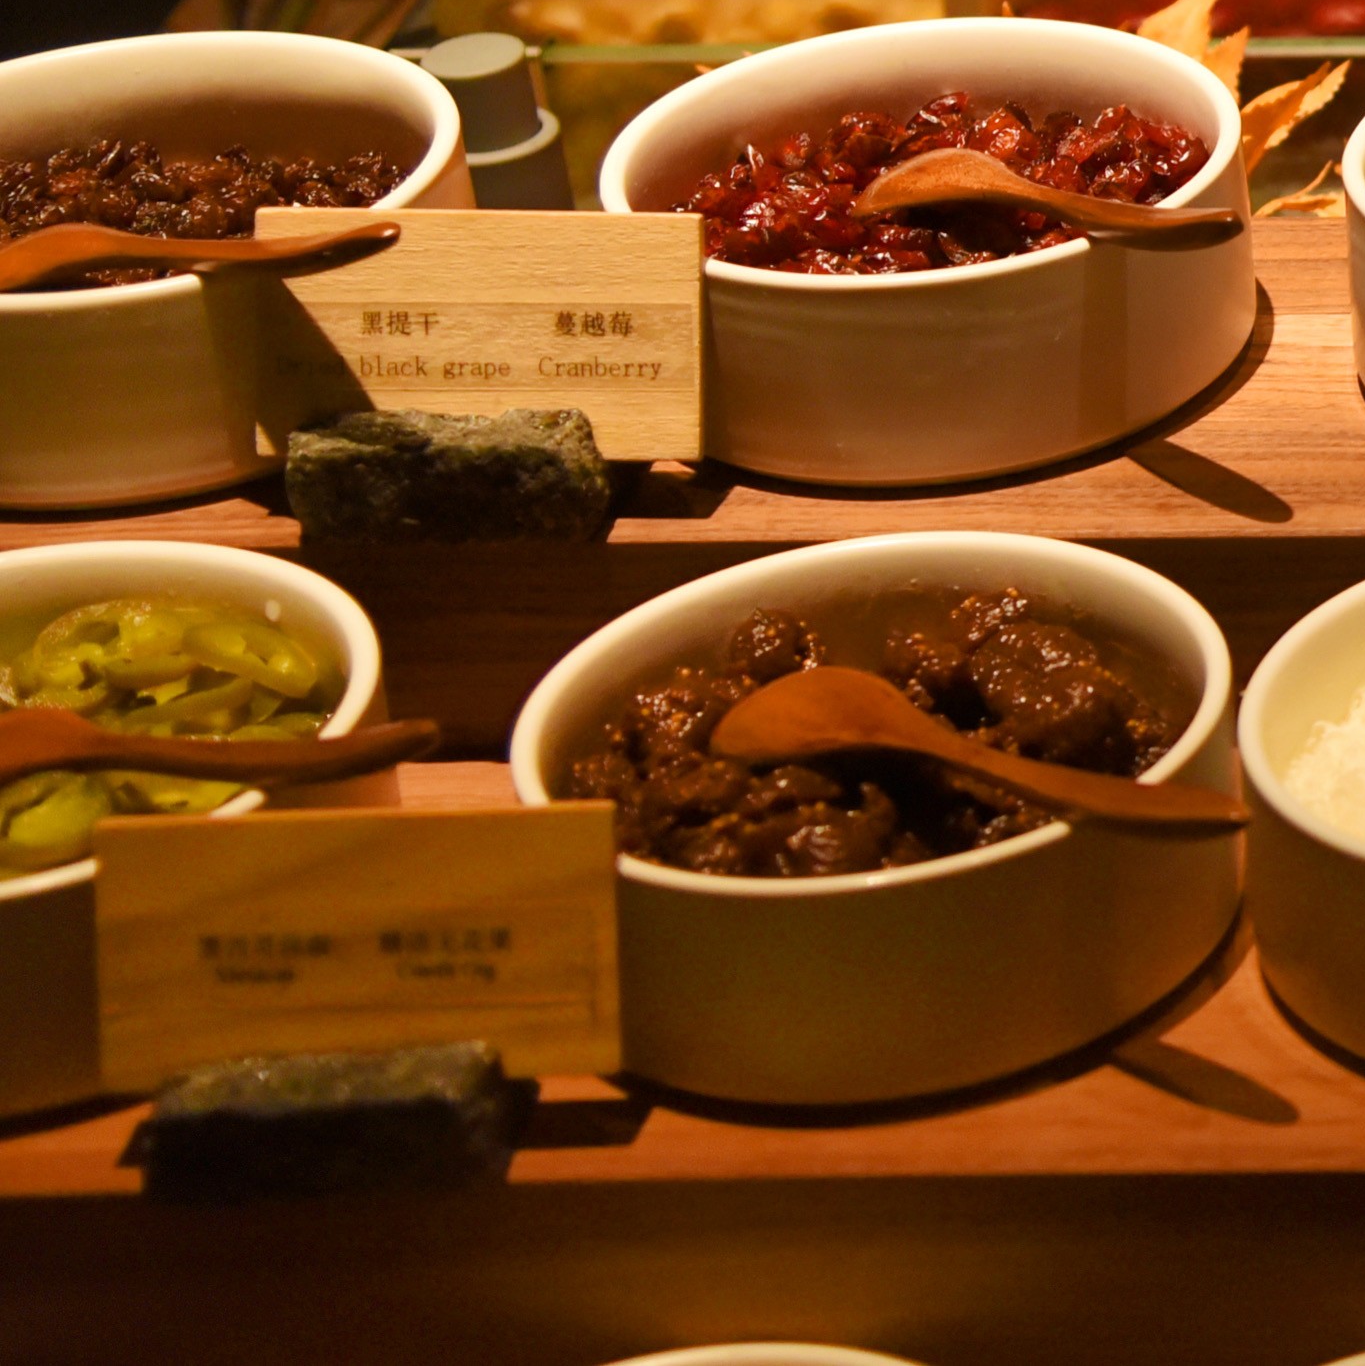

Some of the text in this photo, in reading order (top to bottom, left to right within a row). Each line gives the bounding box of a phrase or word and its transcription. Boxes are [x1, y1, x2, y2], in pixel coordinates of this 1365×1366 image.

[362, 310, 440, 337] 黑提干
[554, 310, 634, 338] 蔓越莓
[359, 355, 428, 378] black
[443, 360, 511, 380] grape
[538, 356, 662, 380] Cranberry
